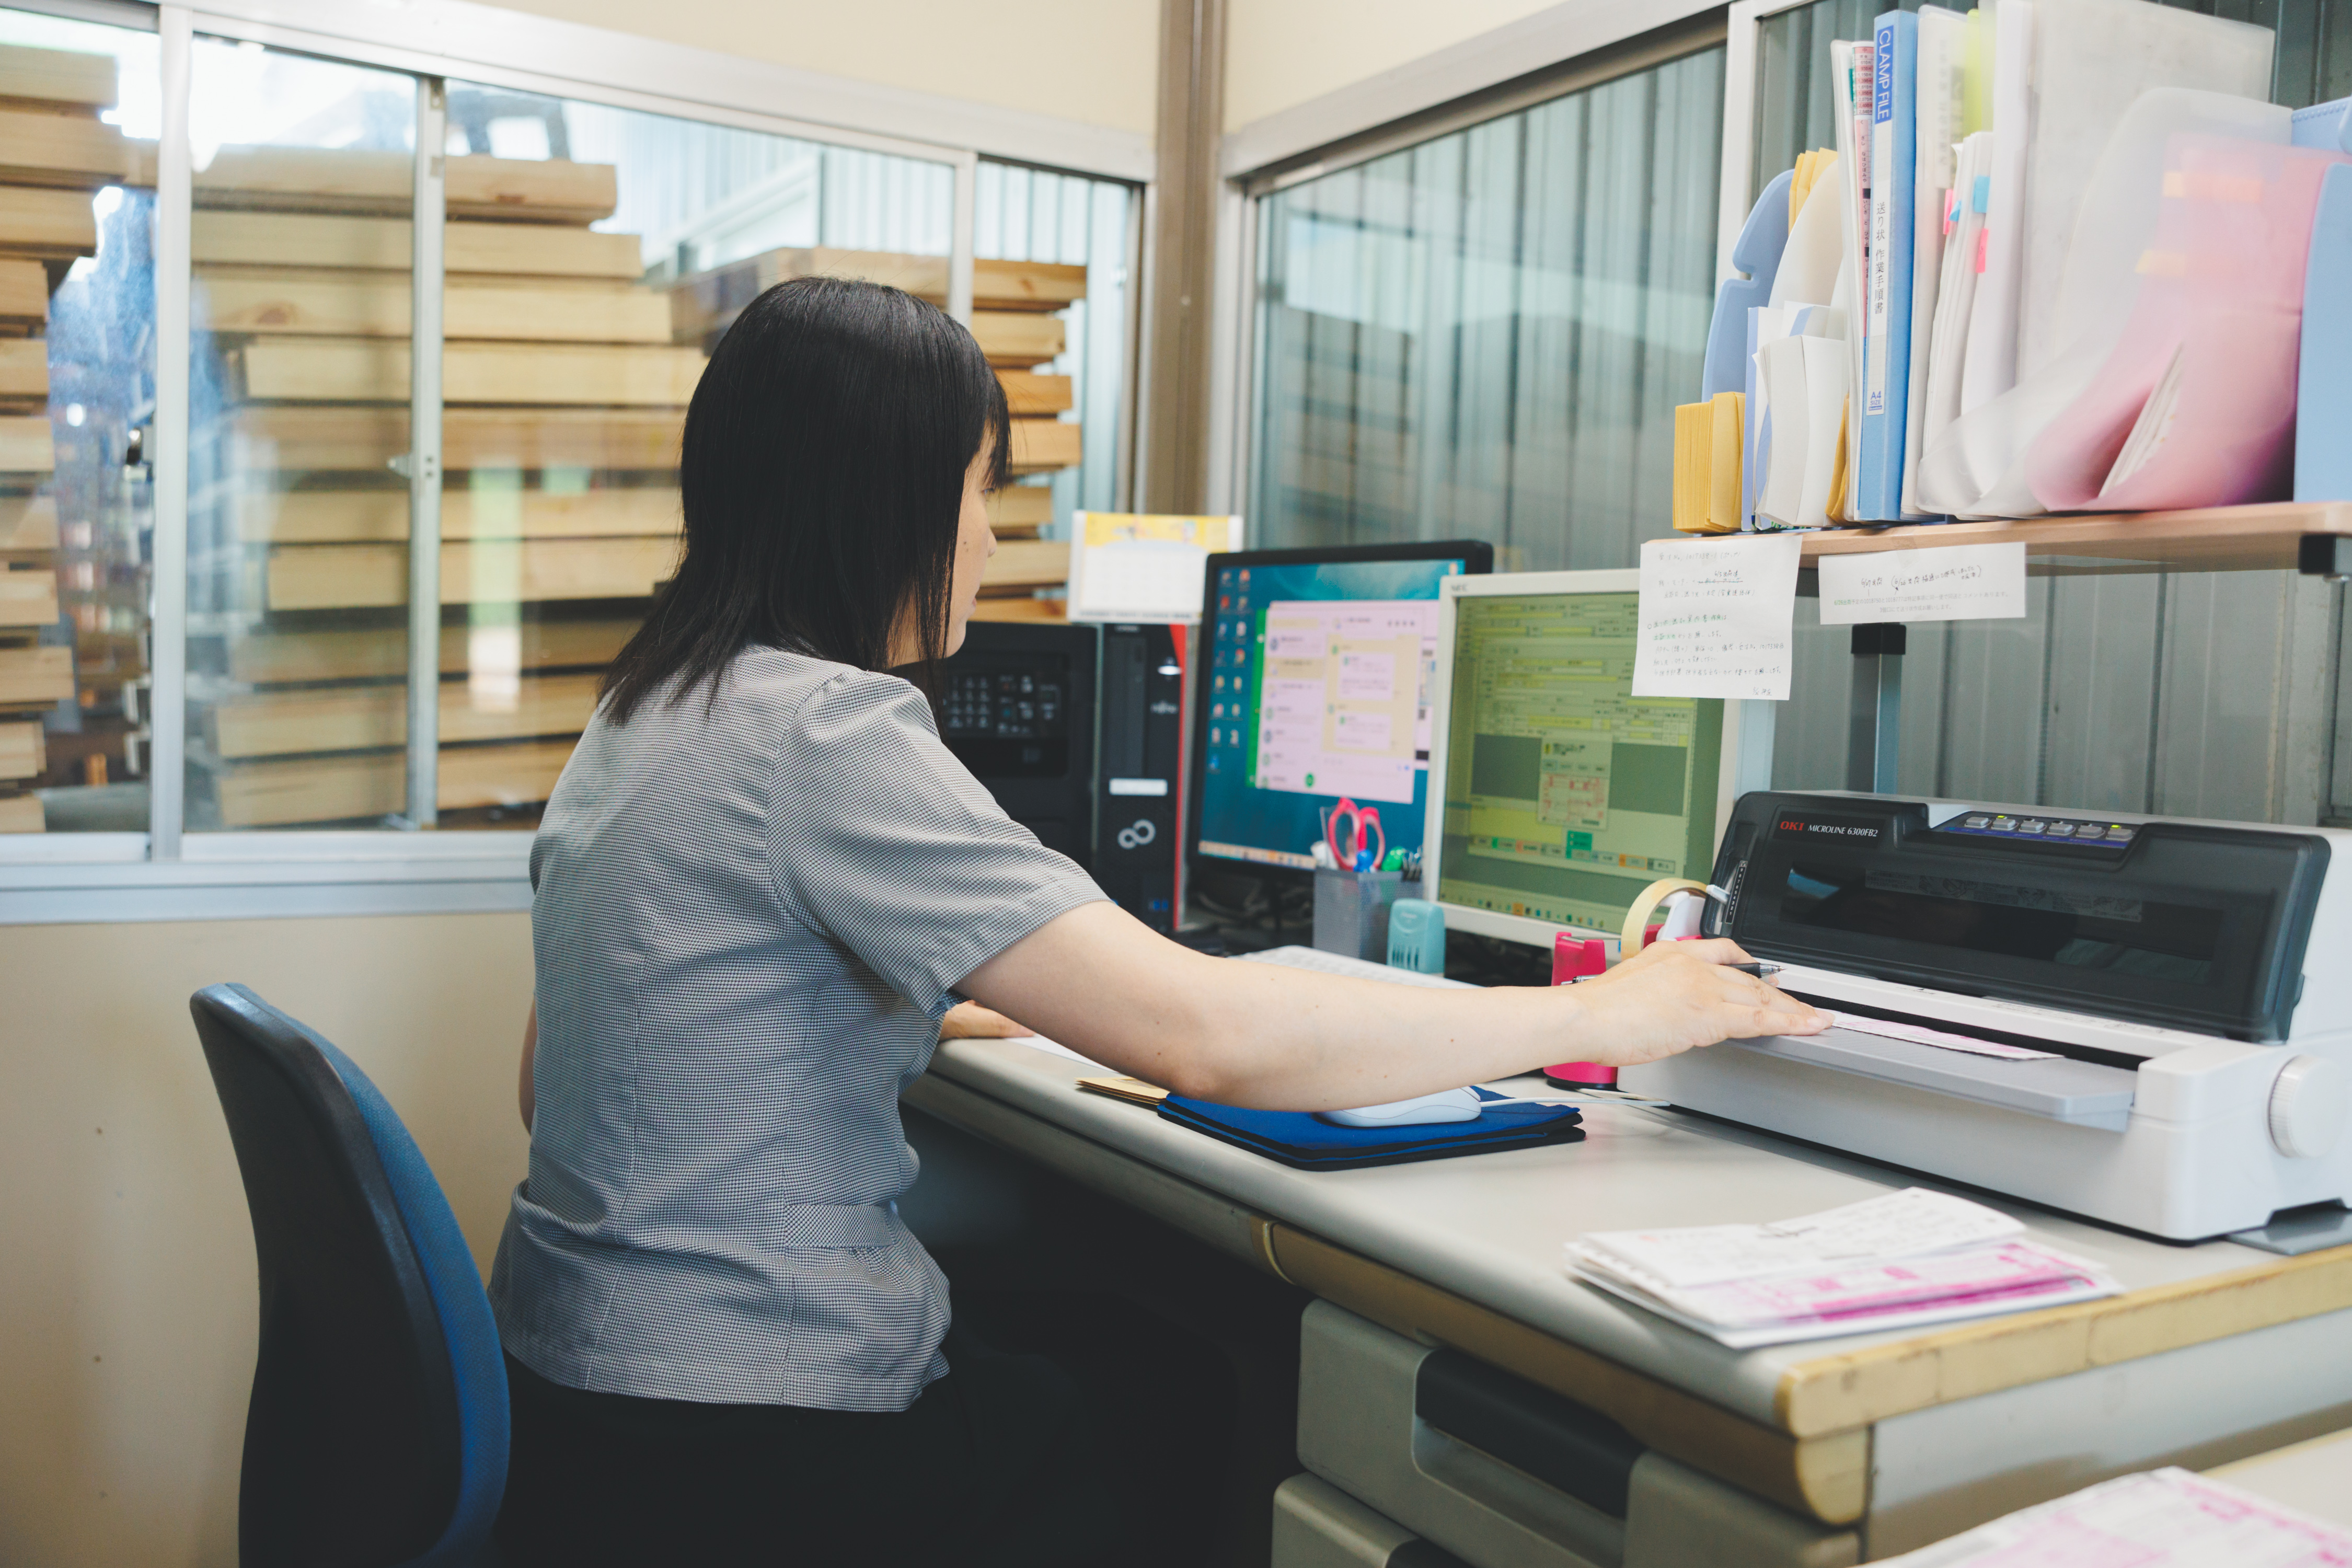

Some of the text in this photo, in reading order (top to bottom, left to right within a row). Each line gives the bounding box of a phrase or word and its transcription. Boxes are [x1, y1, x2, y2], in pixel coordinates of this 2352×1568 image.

[1877, 30, 1890, 120] CLAMP FILE
[1874, 202, 1885, 314] 送り状 作業手順書
[1870, 391, 1882, 400] A4
[1780, 821, 1878, 837] OKI MICROLINE 6300FB2
